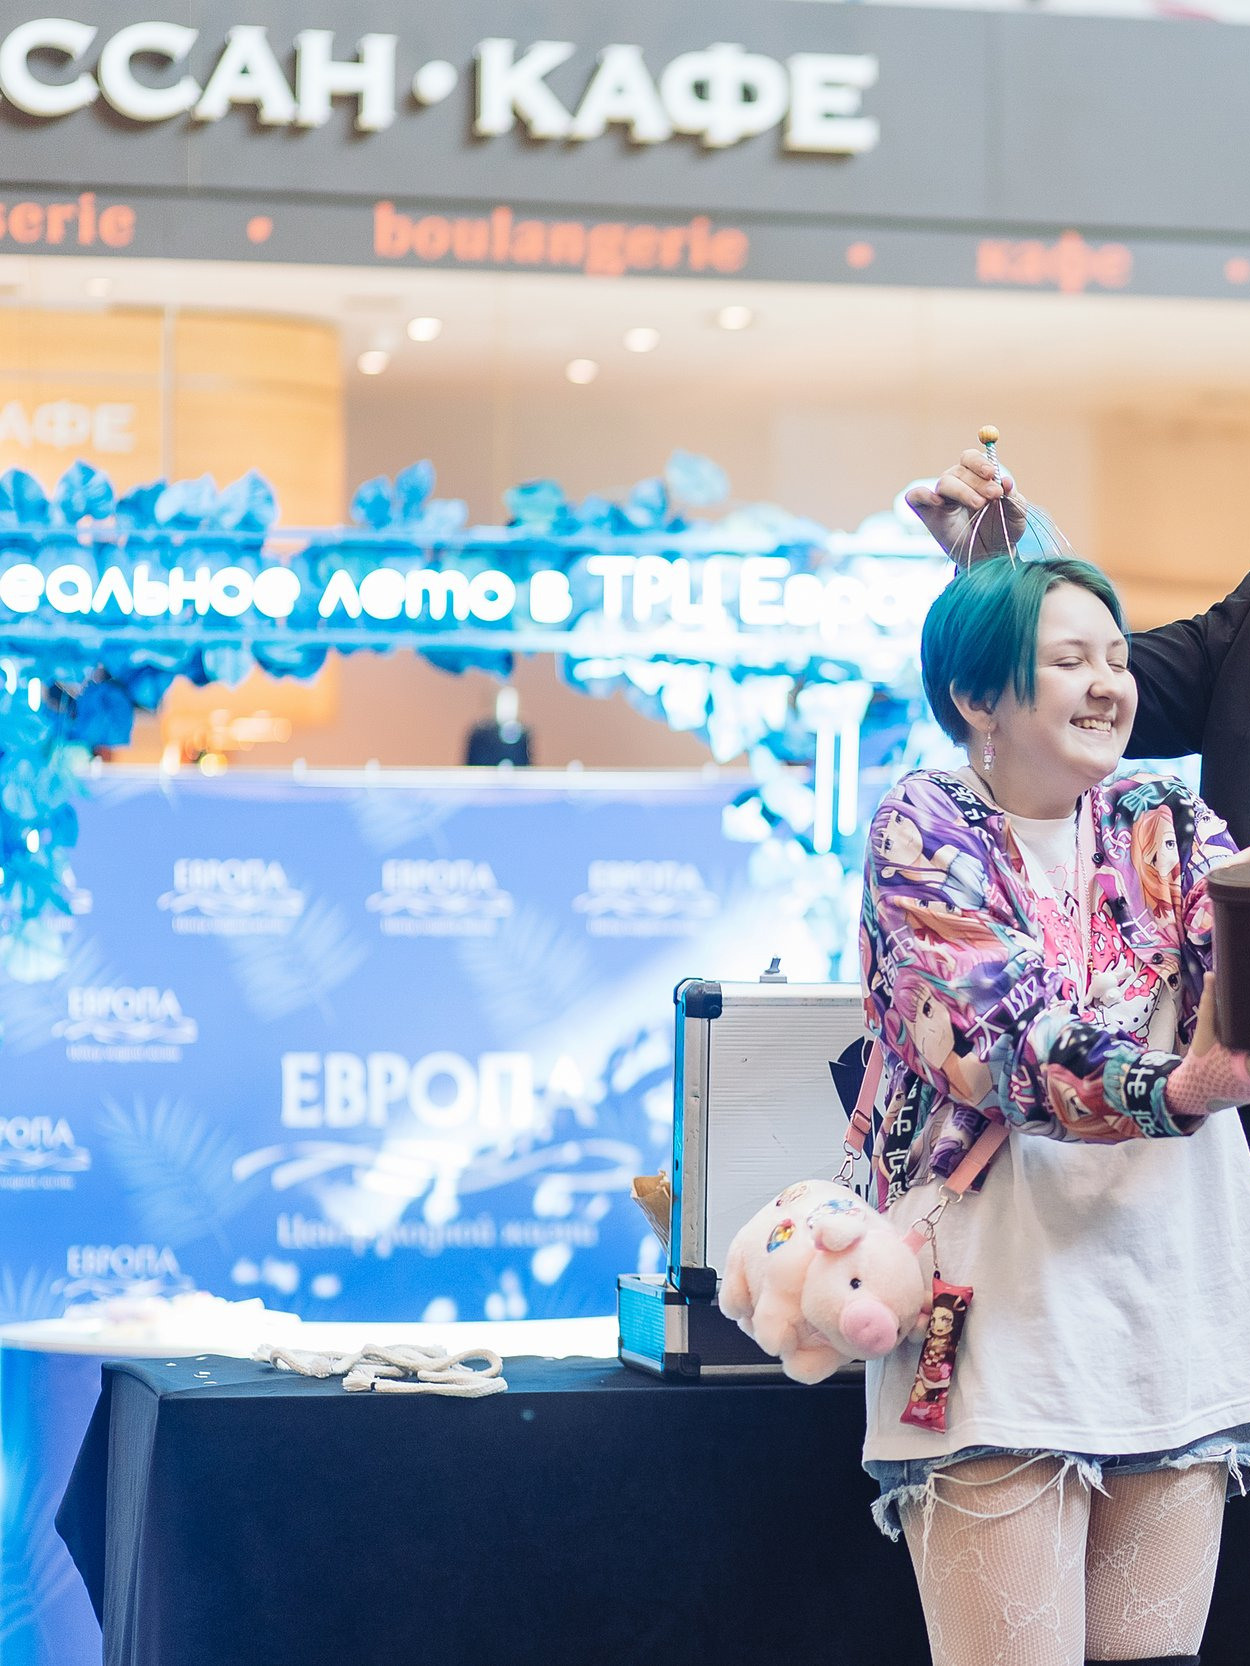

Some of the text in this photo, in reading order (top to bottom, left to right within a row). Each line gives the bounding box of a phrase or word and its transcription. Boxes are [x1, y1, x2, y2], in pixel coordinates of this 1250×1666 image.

[474, 38, 881, 154] КАФЕ
[0, 192, 136, 247] erie
[374, 201, 750, 277] boulangerie
[977, 228, 1132, 295] кафе
[318, 568, 517, 622] лето
[281, 1051, 599, 1130] ЕВРОПА
